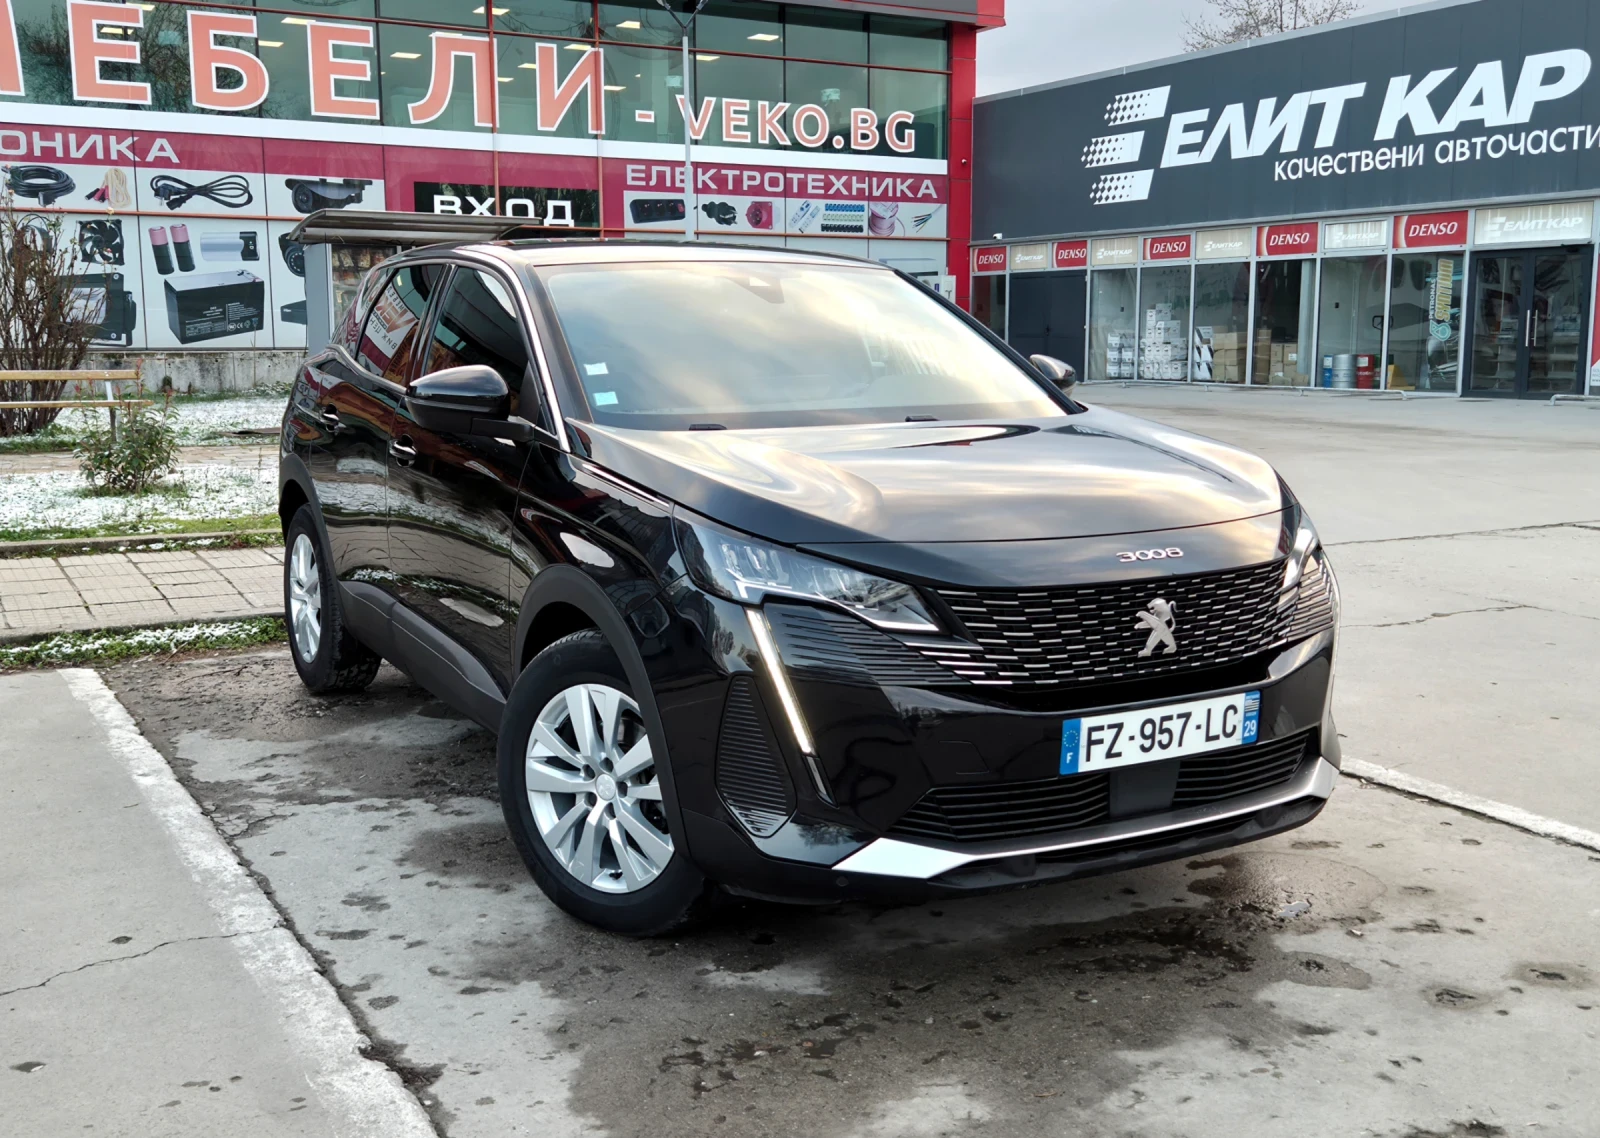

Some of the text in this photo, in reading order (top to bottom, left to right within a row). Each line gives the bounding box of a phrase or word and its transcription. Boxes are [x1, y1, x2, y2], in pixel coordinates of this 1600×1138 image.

[0, 0, 606, 134] ЕБЕЛИ
[675, 94, 916, 153] VEKO.BG
[1160, 48, 1592, 168] ЕЛИТ КАР
[0, 129, 181, 164] ОНИКА
[1274, 124, 1600, 182] качествени авточасти
[625, 164, 938, 200] ЕЛЕКТРОТЕХНИКА
[433, 194, 575, 227] ВХОД
[1408, 221, 1458, 237] DENSO
[1504, 217, 1583, 231] ЕЛИТ КАР
[1152, 241, 1187, 253] DENSO
[1269, 232, 1310, 246] DENSO
[978, 254, 1004, 264] DENSO
[1057, 248, 1086, 260] DENSO
[1428, 278, 1436, 319] PETRONAS
[1116, 547, 1183, 562] 3008
[1084, 703, 1238, 763] FZ-957-LC
[1243, 719, 1257, 737] 29
[1066, 752, 1074, 764] F
